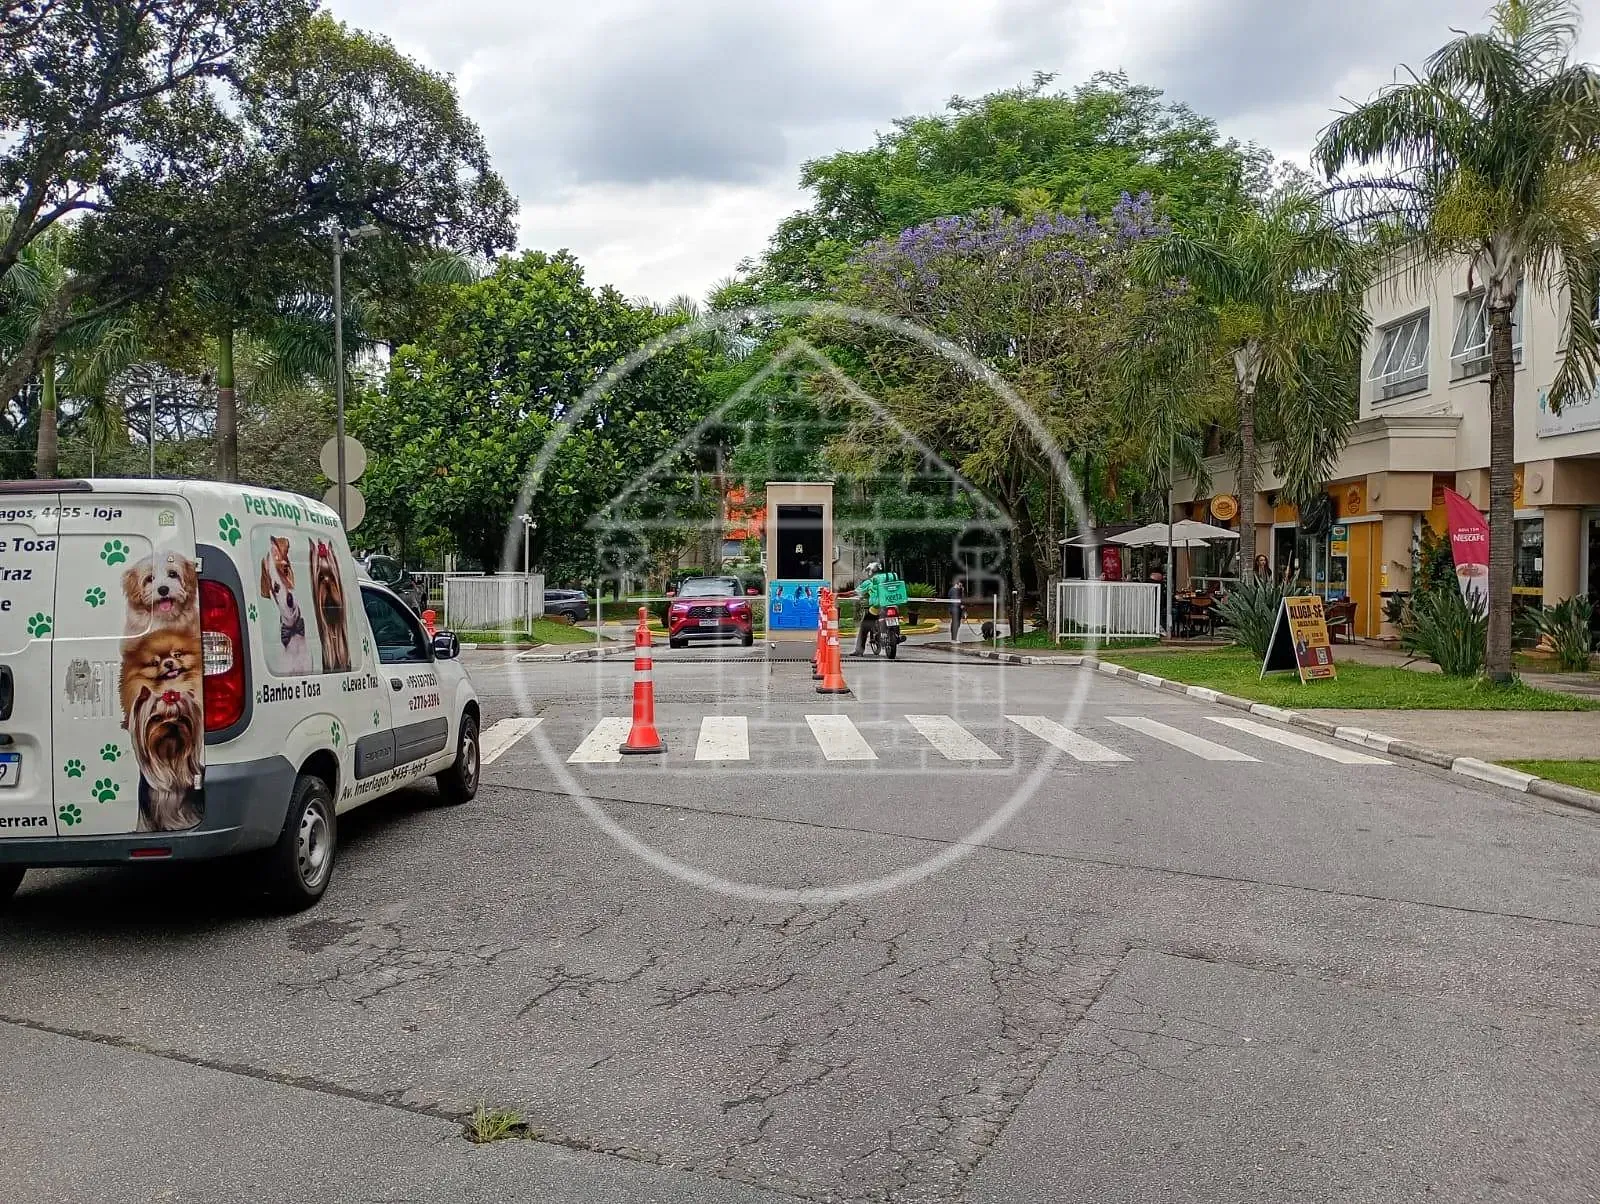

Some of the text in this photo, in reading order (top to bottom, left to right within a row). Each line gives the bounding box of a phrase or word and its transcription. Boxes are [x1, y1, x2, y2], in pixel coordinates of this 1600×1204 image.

[41, 506, 81, 518] 4455
[93, 507, 123, 521] loja
[242, 493, 269, 517] Pet
[268, 497, 301, 526] Shop
[12, 537, 57, 552] Tosa
[1290, 604, 1323, 620] ALUGA-SE
[262, 680, 321, 703] Banho e Tosa
[346, 676, 361, 692] Leva
[341, 786, 353, 800] Av.
[354, 774, 390, 797] Interlagos
